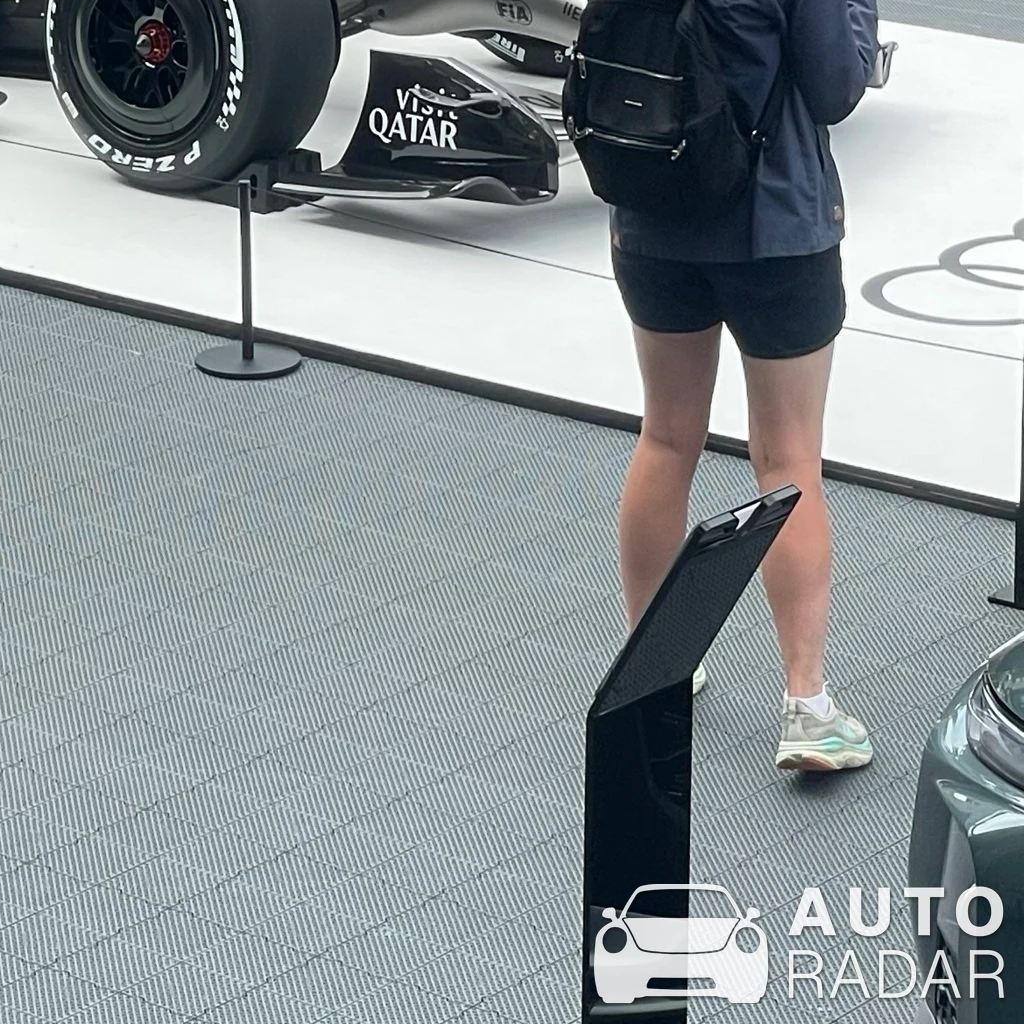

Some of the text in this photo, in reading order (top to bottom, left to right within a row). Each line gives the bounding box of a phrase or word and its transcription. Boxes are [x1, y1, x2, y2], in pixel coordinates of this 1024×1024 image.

[368, 107, 458, 151] QATAR
[87, 133, 201, 173] P ZERO
